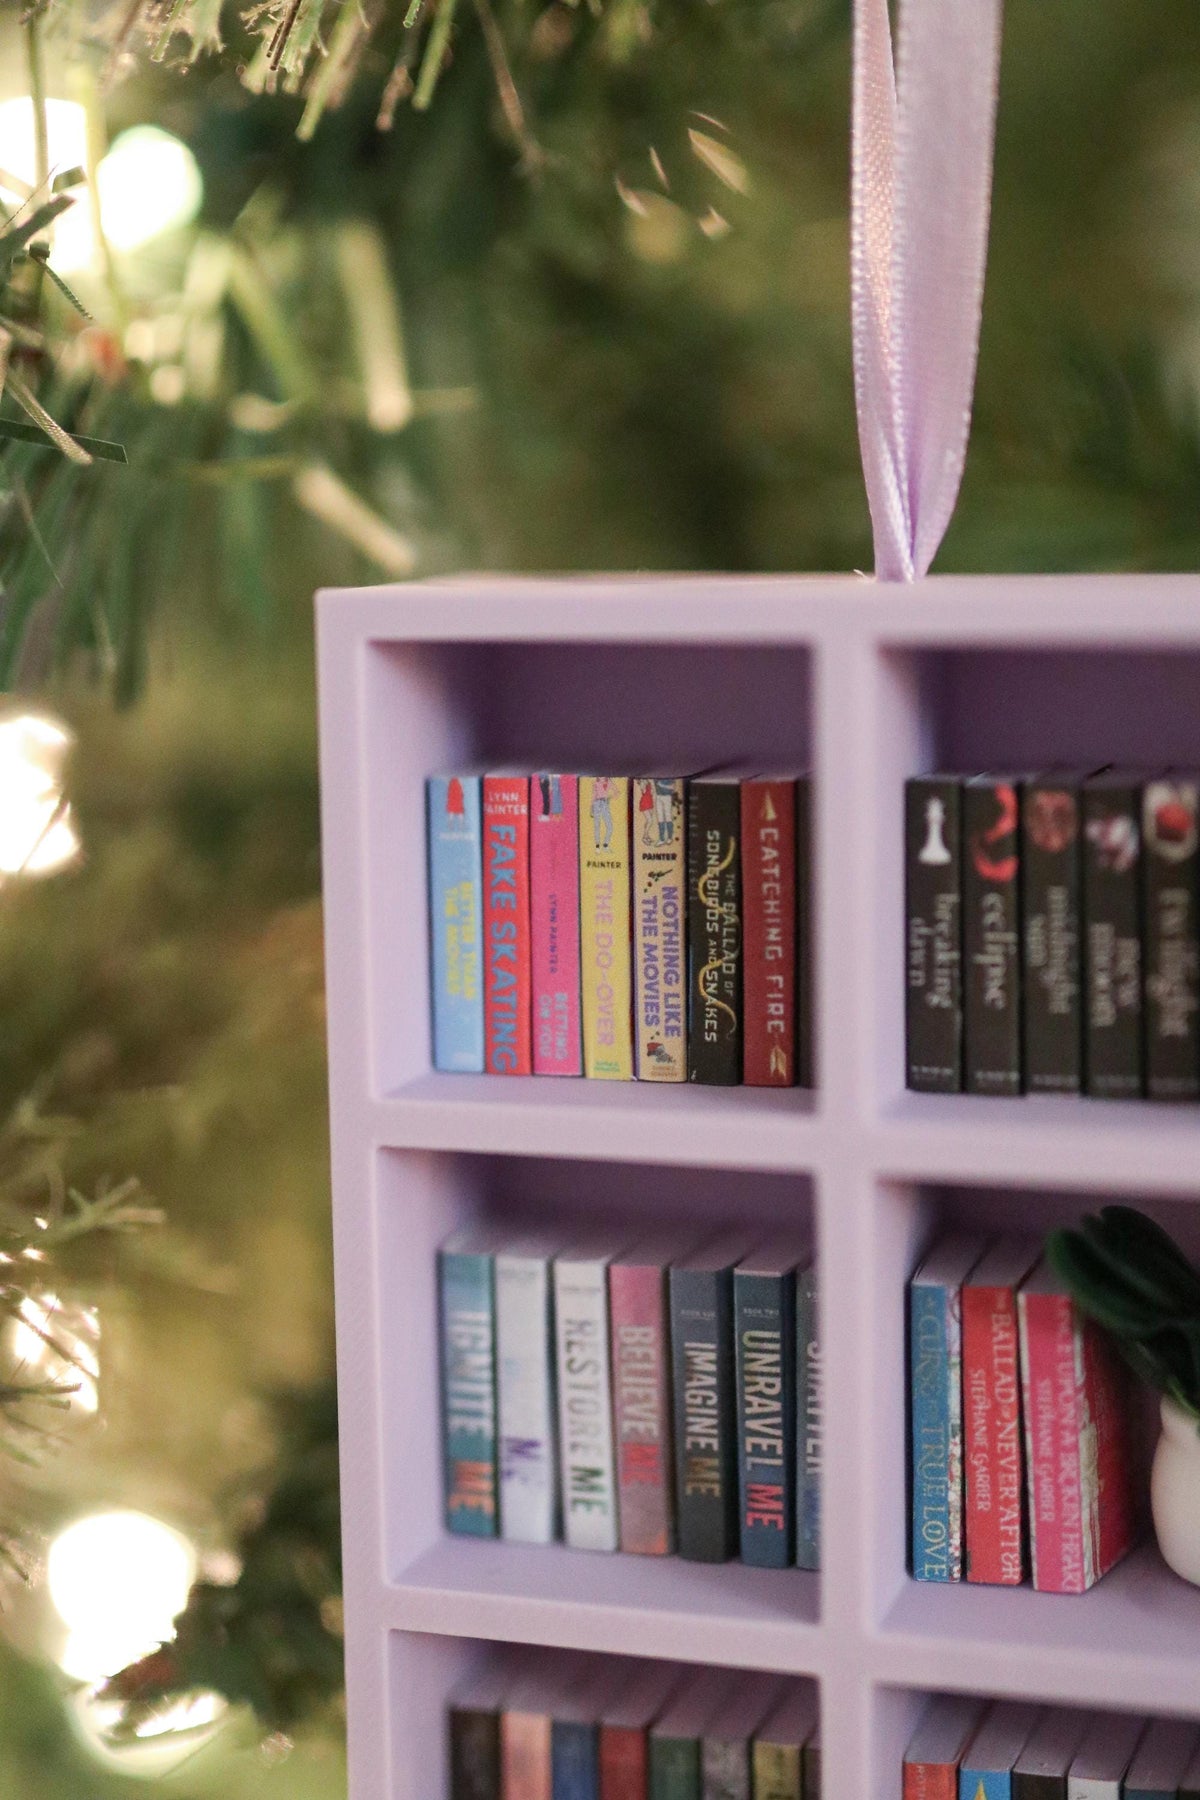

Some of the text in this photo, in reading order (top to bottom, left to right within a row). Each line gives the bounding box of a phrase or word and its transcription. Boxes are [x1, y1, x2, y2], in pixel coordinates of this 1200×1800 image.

[489, 791, 520, 802] LYNN
[587, 860, 621, 870] PAINTER
[595, 880, 614, 925] THE
[642, 852, 677, 862] PAINTER
[706, 829, 721, 933] SONGBIRDS
[724, 873, 736, 896] THE
[490, 824, 518, 1074] FAKE SKATING
[643, 895, 660, 1027] THE MOVIES
[661, 885, 682, 1038] NOTHING LIKE
[722, 901, 736, 974] BALLAD
[759, 826, 785, 1034] CATCHING FIRE
[972, 891, 1018, 1011] eclipse
[540, 994, 553, 1058] ON YOU
[555, 992, 569, 1061] BETTING
[596, 934, 615, 1046] DO-OVER
[704, 967, 719, 1043] SNAKES
[566, 1318, 602, 1457] RESTORE
[618, 1323, 659, 1441] BELIEVE
[991, 1312, 1016, 1403] BALLAD
[447, 1310, 494, 1516] IGNITE ME
[684, 1341, 721, 1499] IMAGINE ME
[742, 1329, 785, 1532] UNRAVEL ME
[968, 1368, 992, 1513] STEPHANIE GARBER
[1036, 1377, 1057, 1522] STEPHANIE GARBER
[570, 1464, 608, 1516] ME
[917, 1422, 948, 1498] TRUE
[994, 1419, 1019, 1500] NEVER
[922, 1505, 948, 1578] LOVE
[998, 1504, 1021, 1581] AFTER
